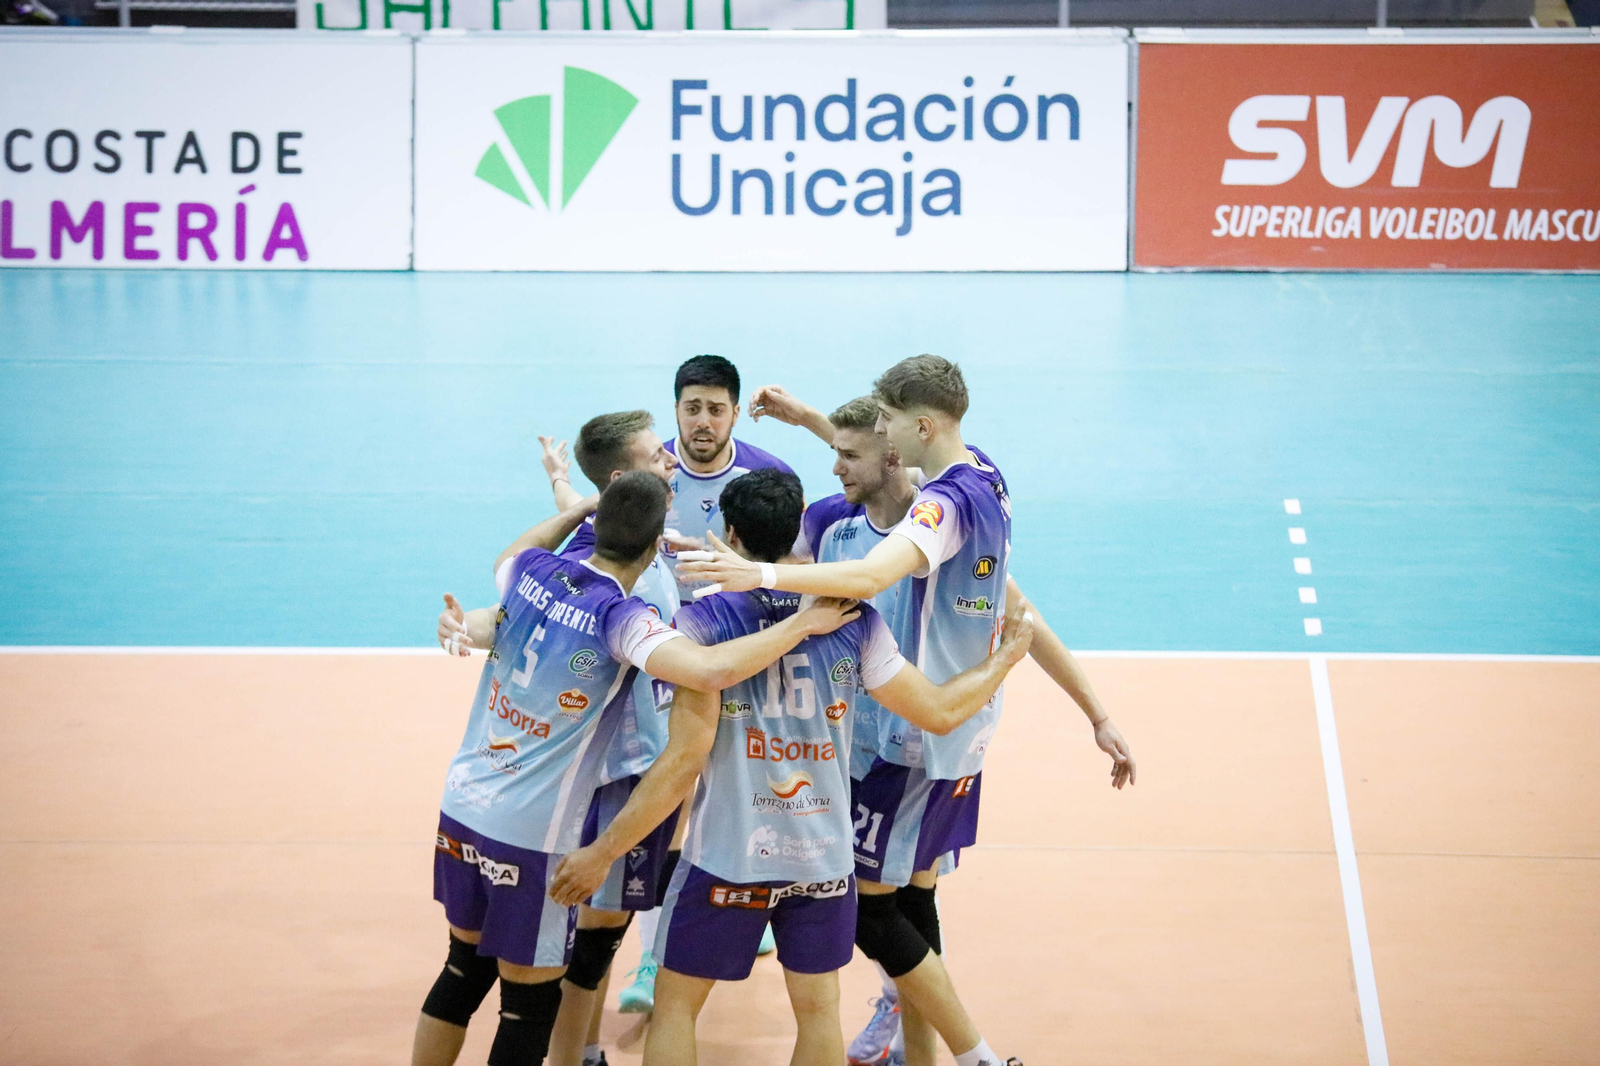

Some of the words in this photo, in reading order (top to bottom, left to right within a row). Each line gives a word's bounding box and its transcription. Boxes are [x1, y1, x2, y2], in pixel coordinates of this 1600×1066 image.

[670, 75, 1080, 142] Fundación
[4, 128, 207, 174] COSTA
[231, 131, 303, 174] DE
[1220, 94, 1532, 189] SVM
[670, 151, 962, 237] Unicaja
[1212, 205, 1361, 239] SUPERLIGA
[1369, 207, 1498, 241] VOLEIBOL
[1503, 208, 1600, 242] MASCU
[511, 622, 546, 689] 5
[575, 656, 597, 668] CSIF
[560, 695, 586, 707] Villar
[762, 653, 816, 719] 16
[497, 695, 551, 739] Soria
[769, 737, 836, 762] Soria
[805, 794, 831, 807] Soria
[853, 802, 884, 854] 21
